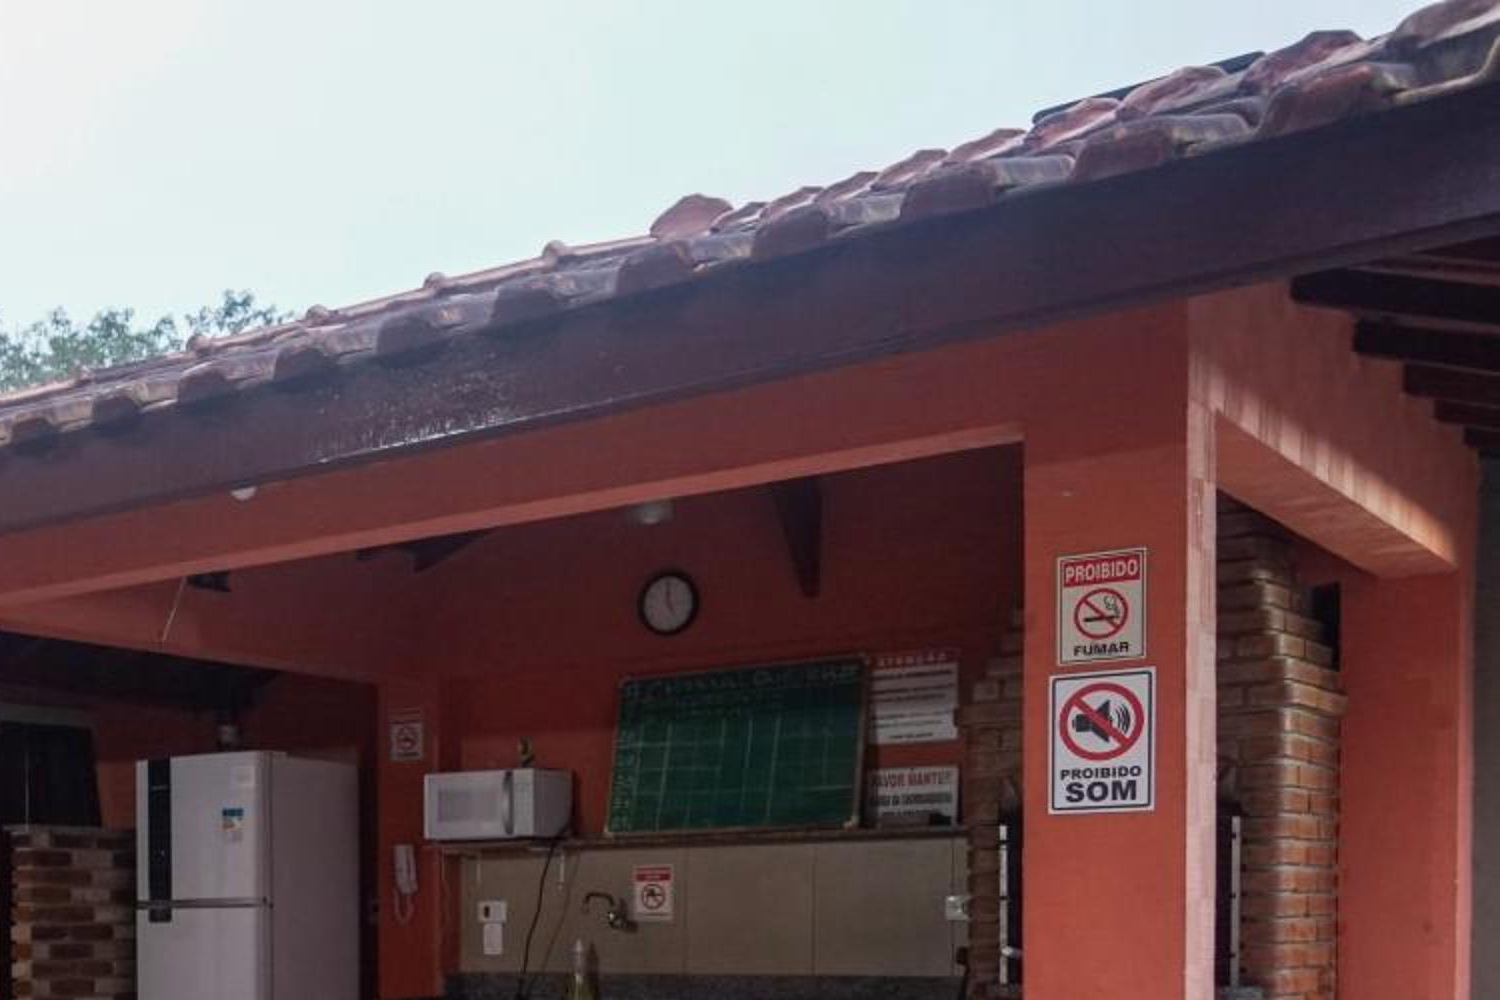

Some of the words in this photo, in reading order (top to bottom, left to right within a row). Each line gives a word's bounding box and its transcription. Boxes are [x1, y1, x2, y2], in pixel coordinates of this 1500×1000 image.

[1064, 559, 1139, 585] PROIBIDO
[1073, 641, 1130, 656] FUMAR
[1060, 765, 1142, 781] PROIBIDO
[1065, 780, 1137, 803] SOM
